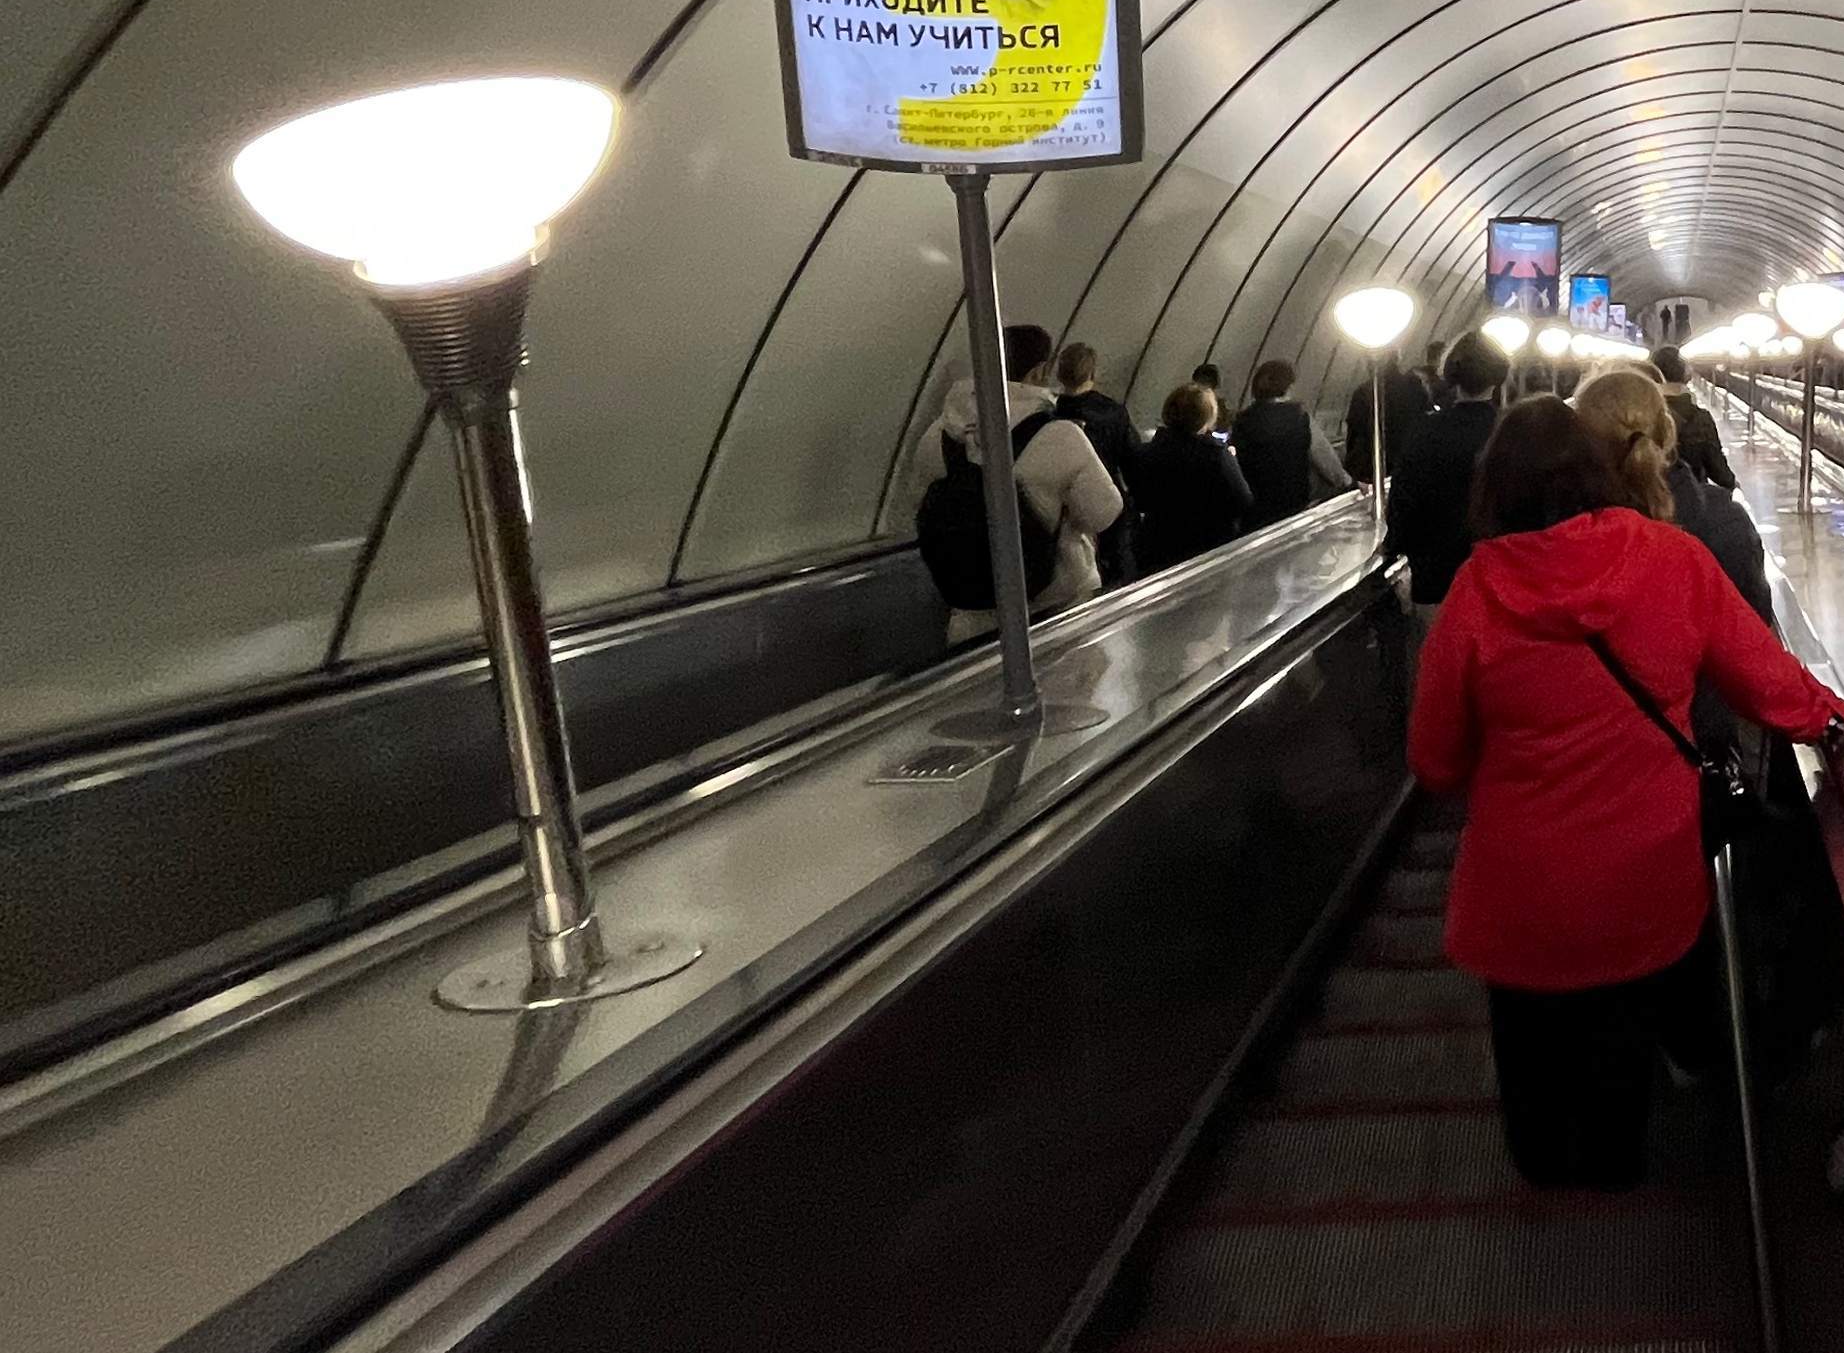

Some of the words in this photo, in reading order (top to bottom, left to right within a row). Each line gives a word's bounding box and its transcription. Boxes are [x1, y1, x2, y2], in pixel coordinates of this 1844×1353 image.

[808, 14, 825, 39] К
[834, 17, 899, 46] НАМ
[908, 24, 1059, 50] УЧИТЬСЯ
[920, 82, 938, 94] +7
[950, 82, 998, 97] (812)
[1010, 82, 1040, 94] 322
[1051, 81, 1071, 92] 77
[1083, 79, 1102, 90] 51
